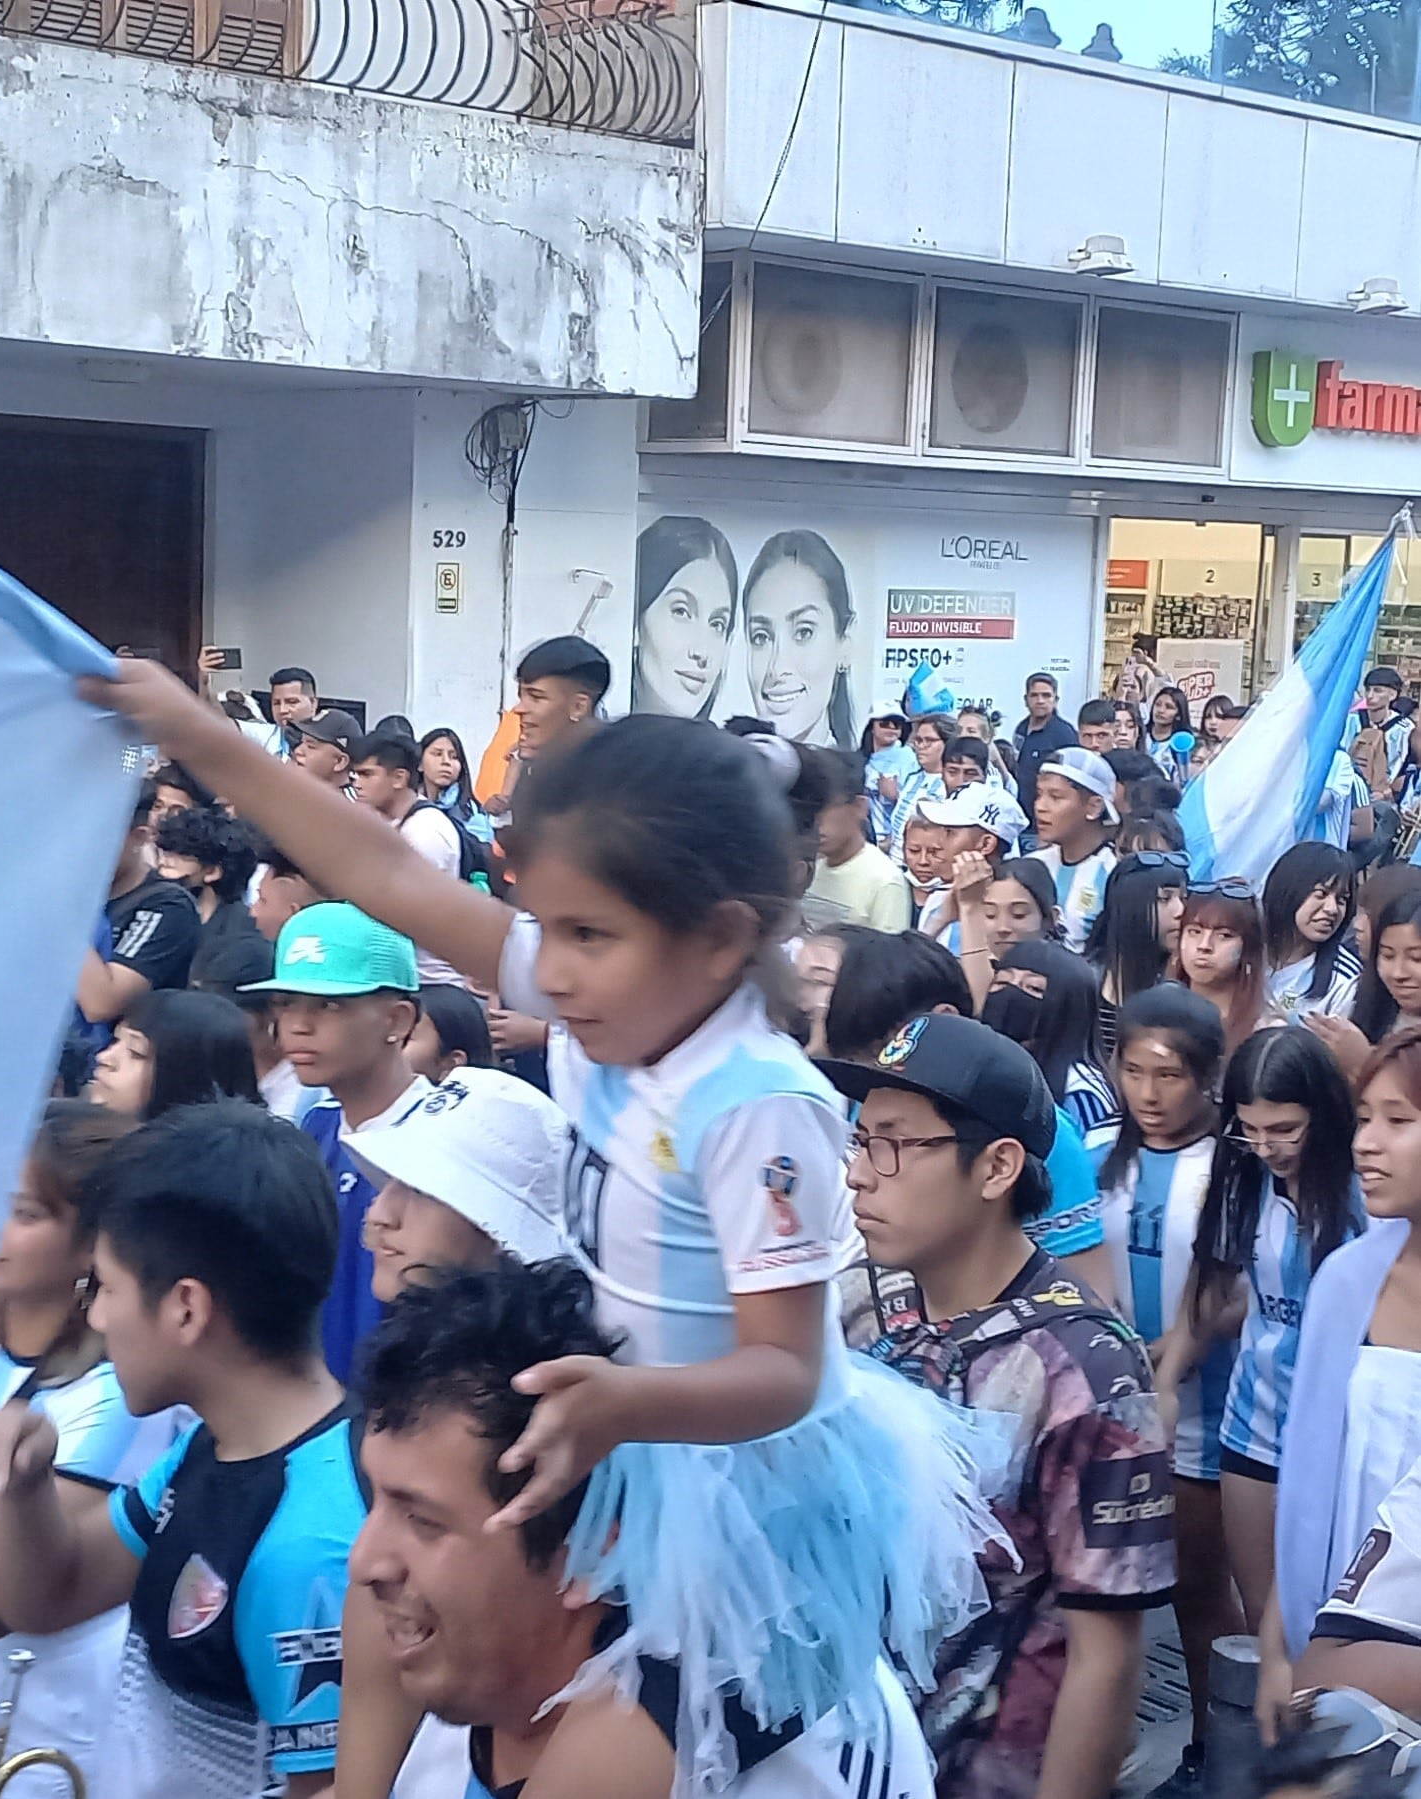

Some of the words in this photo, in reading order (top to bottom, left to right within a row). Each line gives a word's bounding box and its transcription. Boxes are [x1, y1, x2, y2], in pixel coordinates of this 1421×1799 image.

[1318, 359, 1421, 434] farm
[433, 529, 467, 548] 529
[1205, 569, 1215, 583] 2
[1311, 572, 1321, 587] 3
[890, 594, 915, 614] UV
[920, 594, 1011, 615] DEFENDER
[889, 621, 928, 634] FLUIDO
[931, 621, 982, 634] INVISIBLE
[979, 803, 1000, 826] NY
